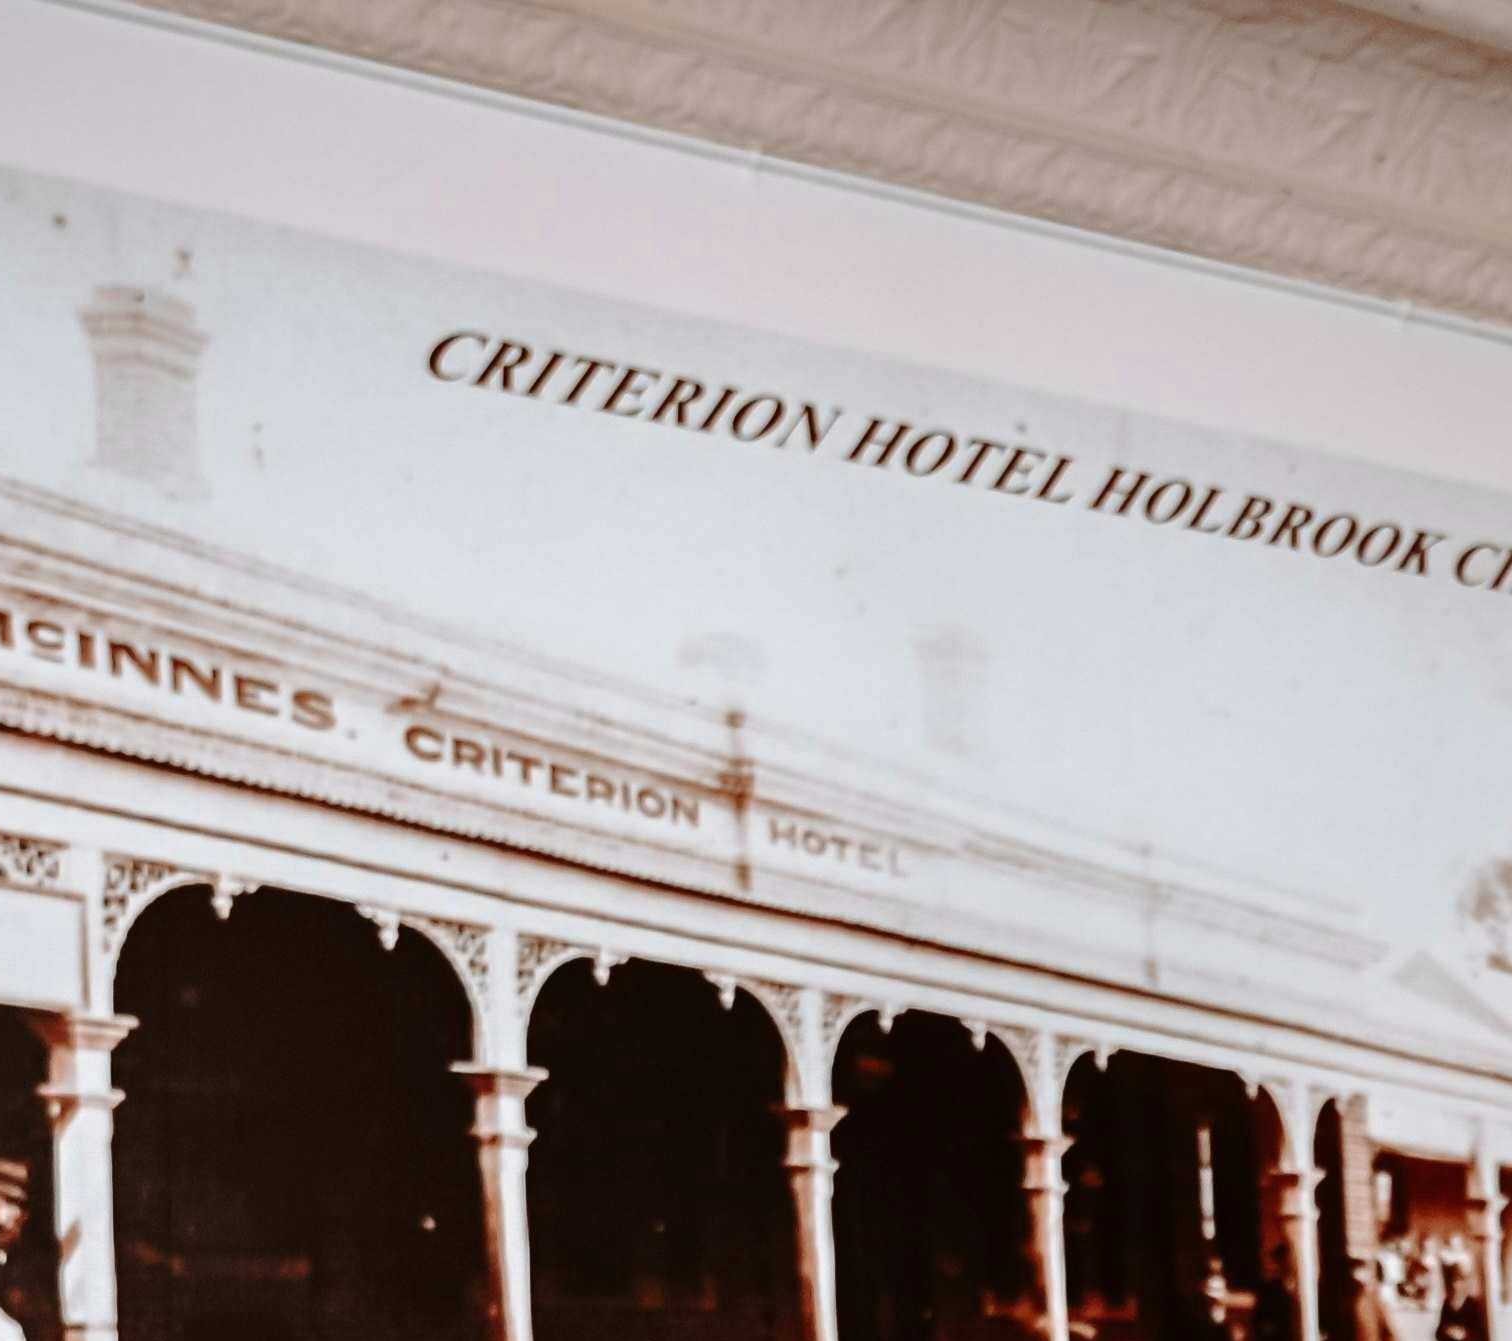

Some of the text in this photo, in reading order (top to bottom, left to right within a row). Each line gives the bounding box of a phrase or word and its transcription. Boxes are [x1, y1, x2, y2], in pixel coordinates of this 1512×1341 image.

[425, 327, 841, 453] CRITERION
[846, 415, 1076, 506] HOTEL
[1088, 465, 1448, 579] HOLBROOK
[401, 722, 701, 830] CRITERION
[768, 816, 910, 879] HOTEL
